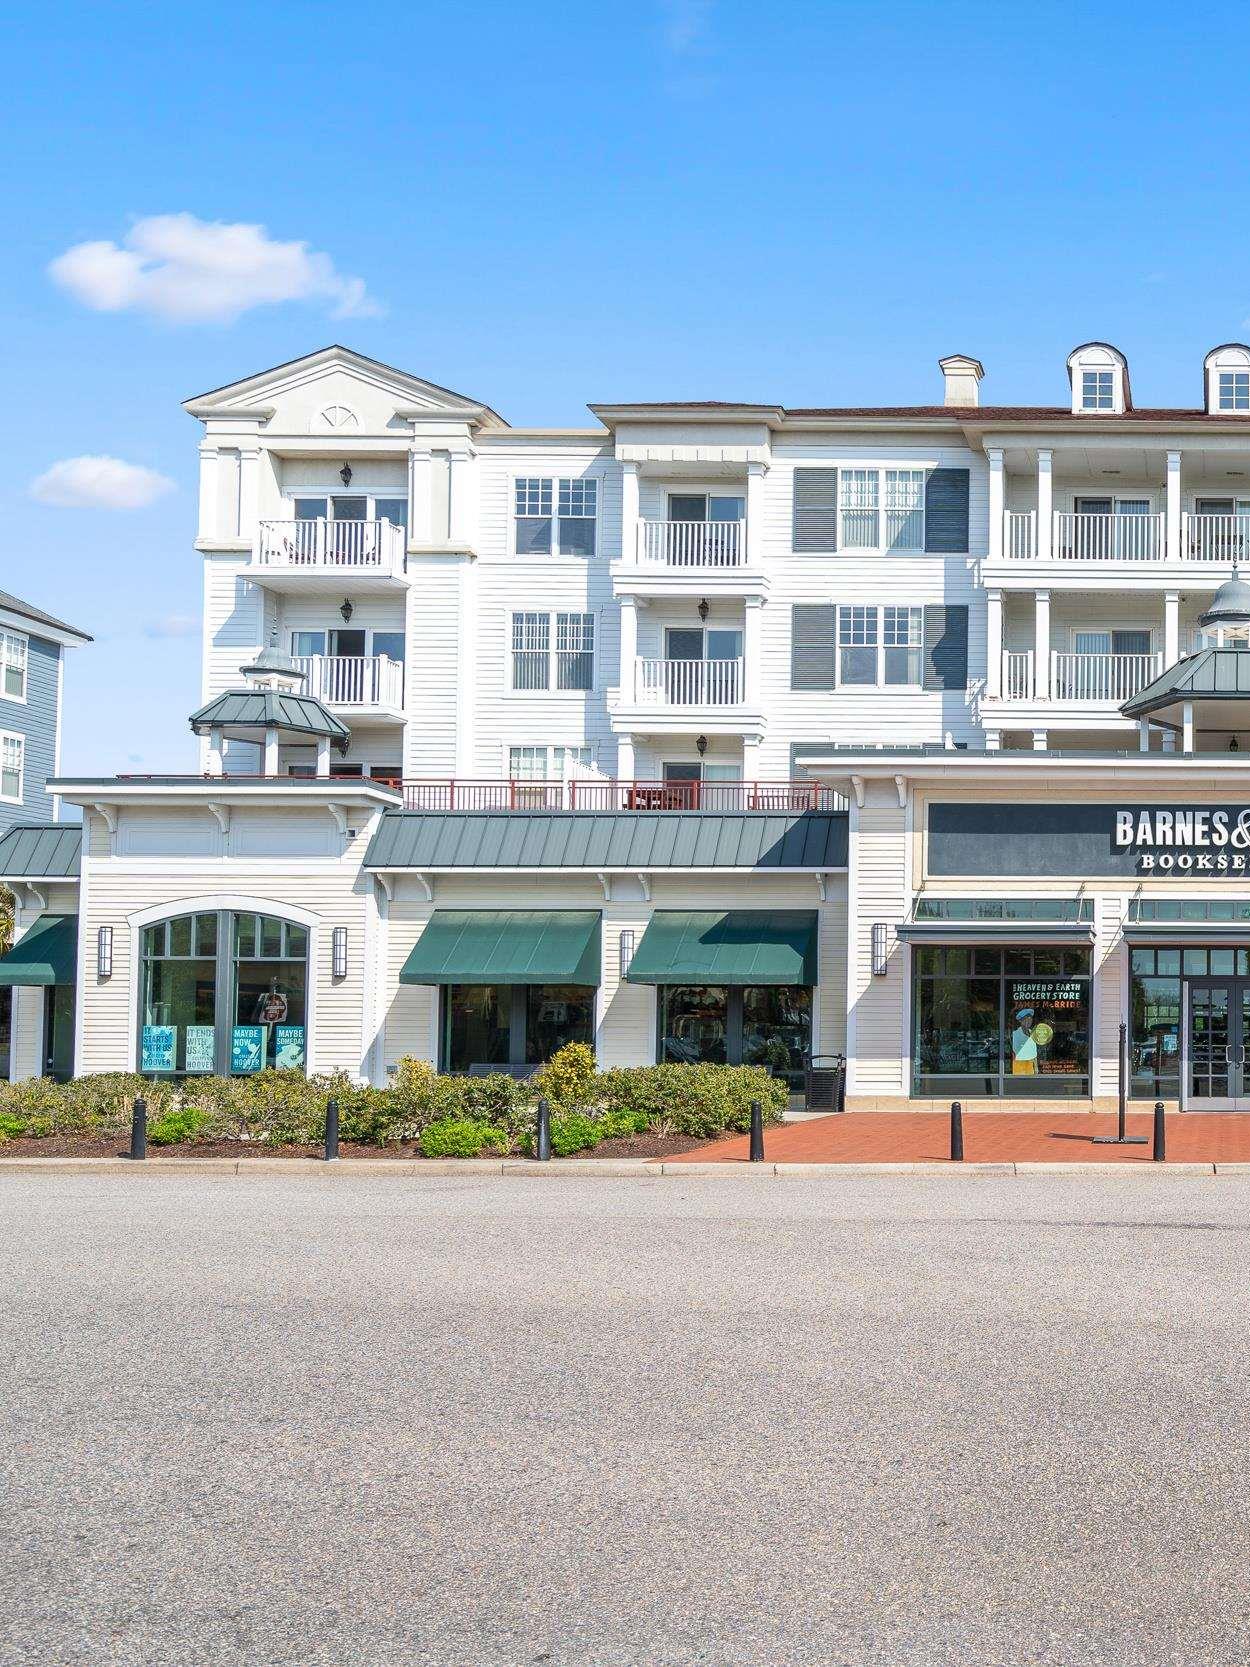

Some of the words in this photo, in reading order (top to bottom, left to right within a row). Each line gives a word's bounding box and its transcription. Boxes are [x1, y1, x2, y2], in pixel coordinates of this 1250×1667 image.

[1013, 992, 1050, 1000] GROCERY
[196, 1029, 215, 1037] ENDS
[234, 1029, 259, 1037] MAYBE
[278, 1029, 303, 1037] MAYBE
[187, 1038, 206, 1046] WITH
[187, 1046, 197, 1054] US
